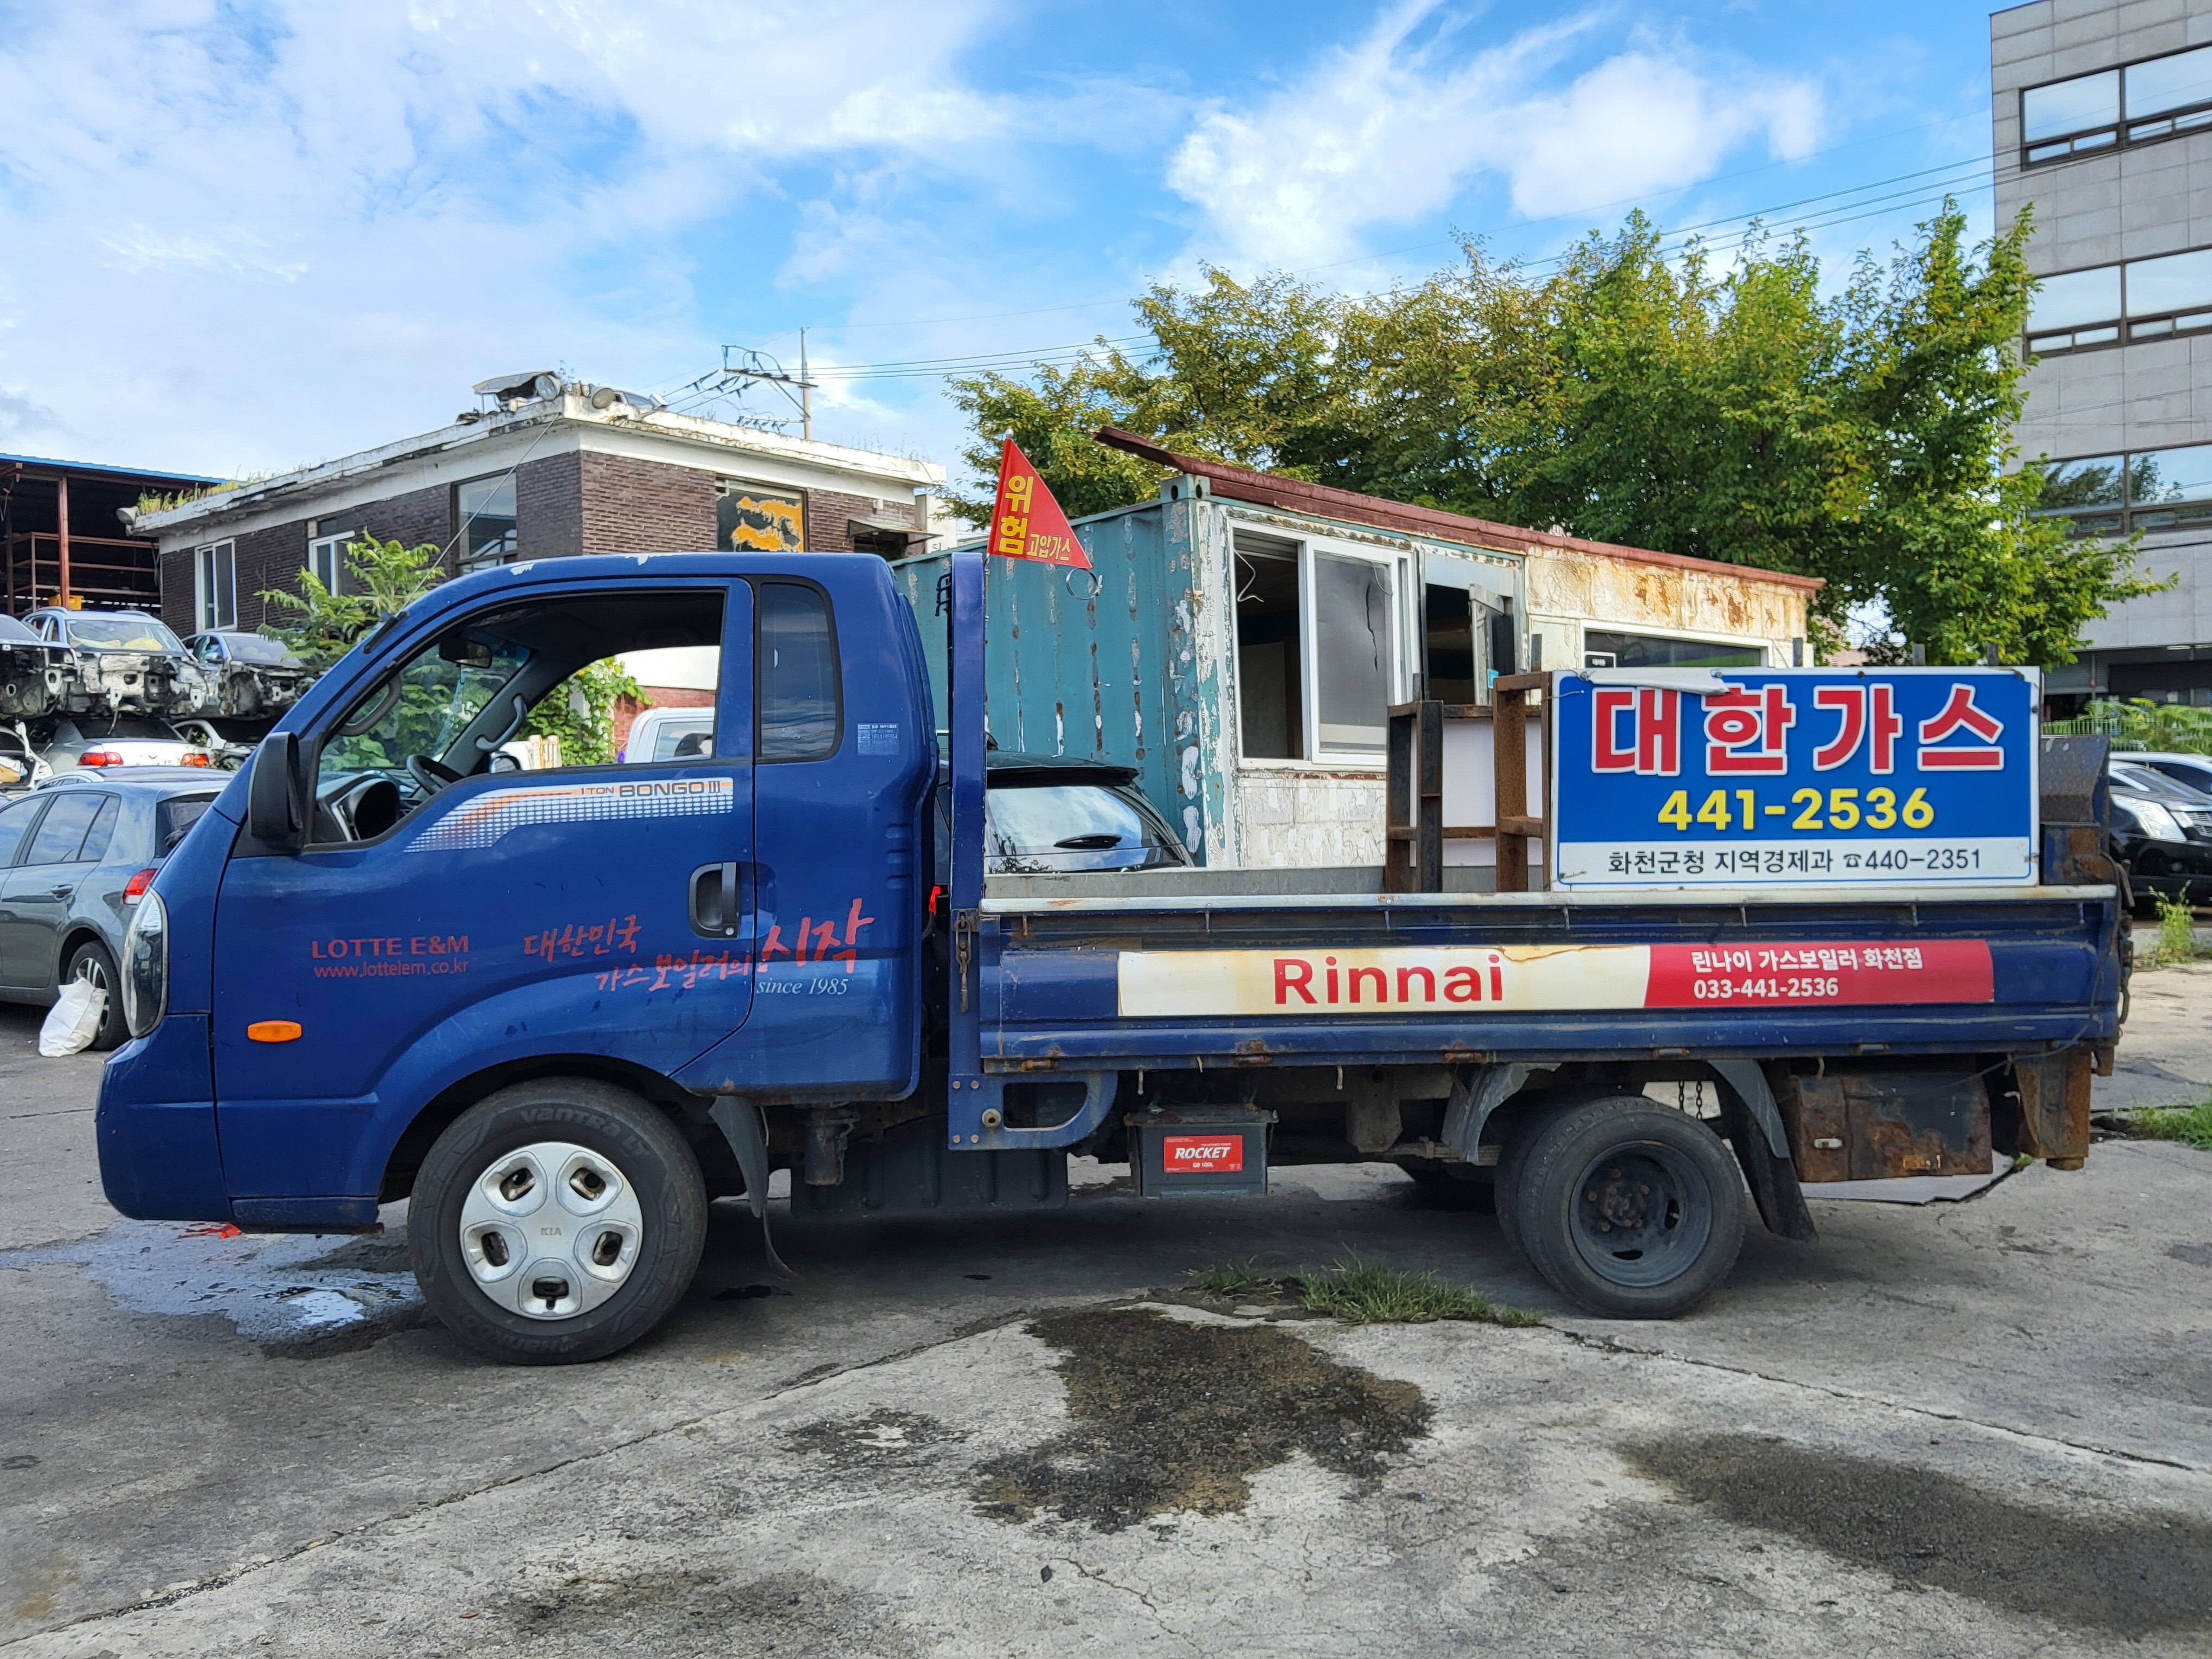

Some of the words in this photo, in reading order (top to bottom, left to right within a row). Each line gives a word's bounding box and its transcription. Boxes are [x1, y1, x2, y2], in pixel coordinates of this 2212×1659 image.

[999, 475, 1034, 555] 위험
[1027, 533, 1071, 561] 고압가스
[1591, 682, 2004, 776] 대한가스
[619, 781, 705, 798] BONGO
[1657, 787, 1935, 831] 441-2536
[1608, 850, 1704, 875] 화천군청
[1714, 848, 1834, 874] 지역경제과
[312, 937, 403, 959] LOTTE
[410, 935, 469, 955] E&M
[524, 914, 642, 962] 대한민국
[757, 898, 875, 974] 시작
[313, 957, 469, 979] www.lottelem.co.kr
[1691, 949, 1753, 973] 린나이
[1758, 948, 1859, 971] 가스보일러
[1862, 946, 1924, 970] 화천점
[756, 978, 803, 995] since
[808, 978, 849, 995] 1985
[1273, 954, 1503, 1005] Rinnai
[1694, 977, 1840, 999] 033-441-2536
[1174, 1147, 1231, 1160] ROCKET
[541, 1227, 562, 1237] KIA
